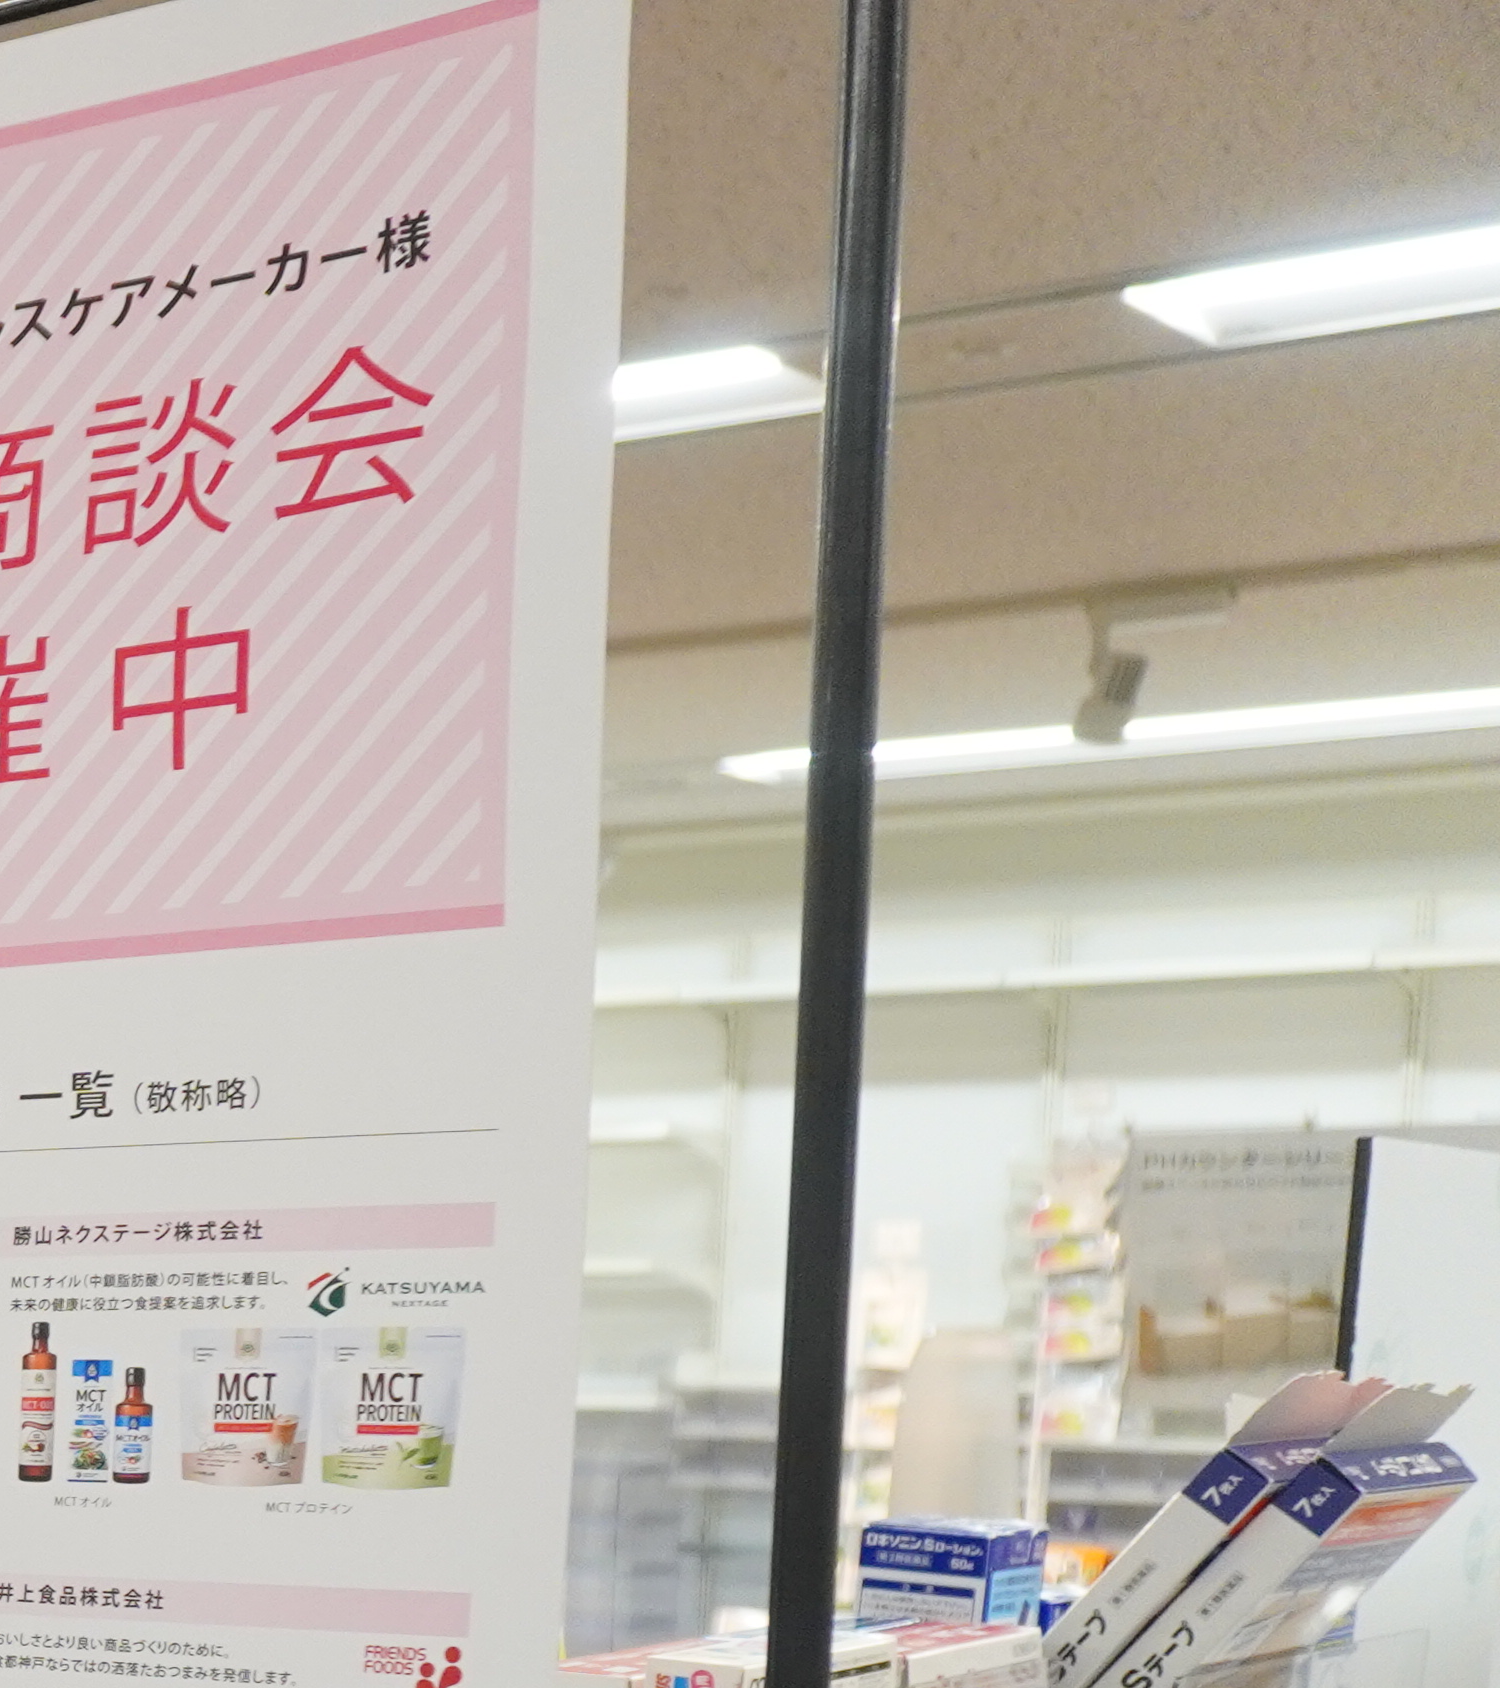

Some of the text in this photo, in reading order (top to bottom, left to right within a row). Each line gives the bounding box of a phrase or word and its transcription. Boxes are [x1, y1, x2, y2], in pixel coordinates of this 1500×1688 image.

[18, 1070, 115, 1121] 一覧
[13, 1219, 264, 1246] 勝山ネクステージ株式会社
[11, 1275, 40, 1290] MCT
[361, 1280, 486, 1296] KATSUYAMA
[392, 1300, 449, 1308] NEXTAGE
[75, 1388, 107, 1402] MCT
[217, 1373, 277, 1402] MCT
[361, 1373, 424, 1402] MCT
[214, 1403, 276, 1421] PROTEIN
[357, 1404, 422, 1422] PROTEIN
[364, 1644, 428, 1662] FRIENDS
[363, 1658, 415, 1676] FOODS
